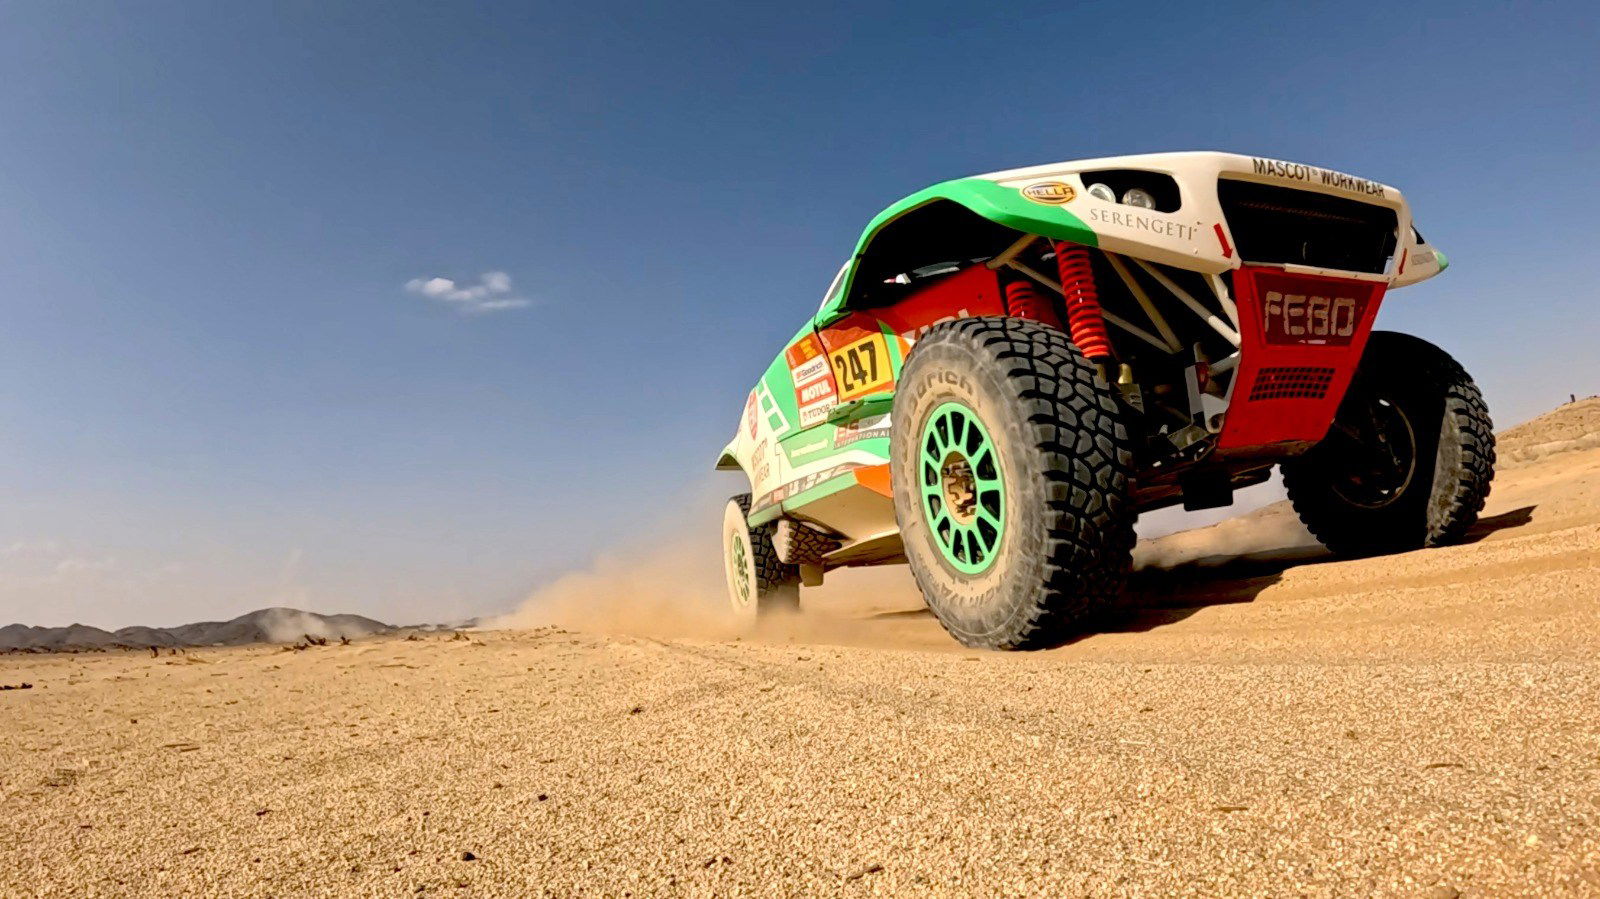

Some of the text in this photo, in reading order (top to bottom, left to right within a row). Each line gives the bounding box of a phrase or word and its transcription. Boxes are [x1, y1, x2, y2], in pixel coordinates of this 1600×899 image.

[1027, 186, 1075, 197] HELLA
[1252, 158, 1386, 198] MASCOT WORKWEAR
[1090, 208, 1193, 240] SERENGETI
[1264, 290, 1356, 337] FEBO
[834, 340, 878, 393] 247
[801, 379, 832, 403] MOTUL
[808, 403, 831, 419] TUDOR
